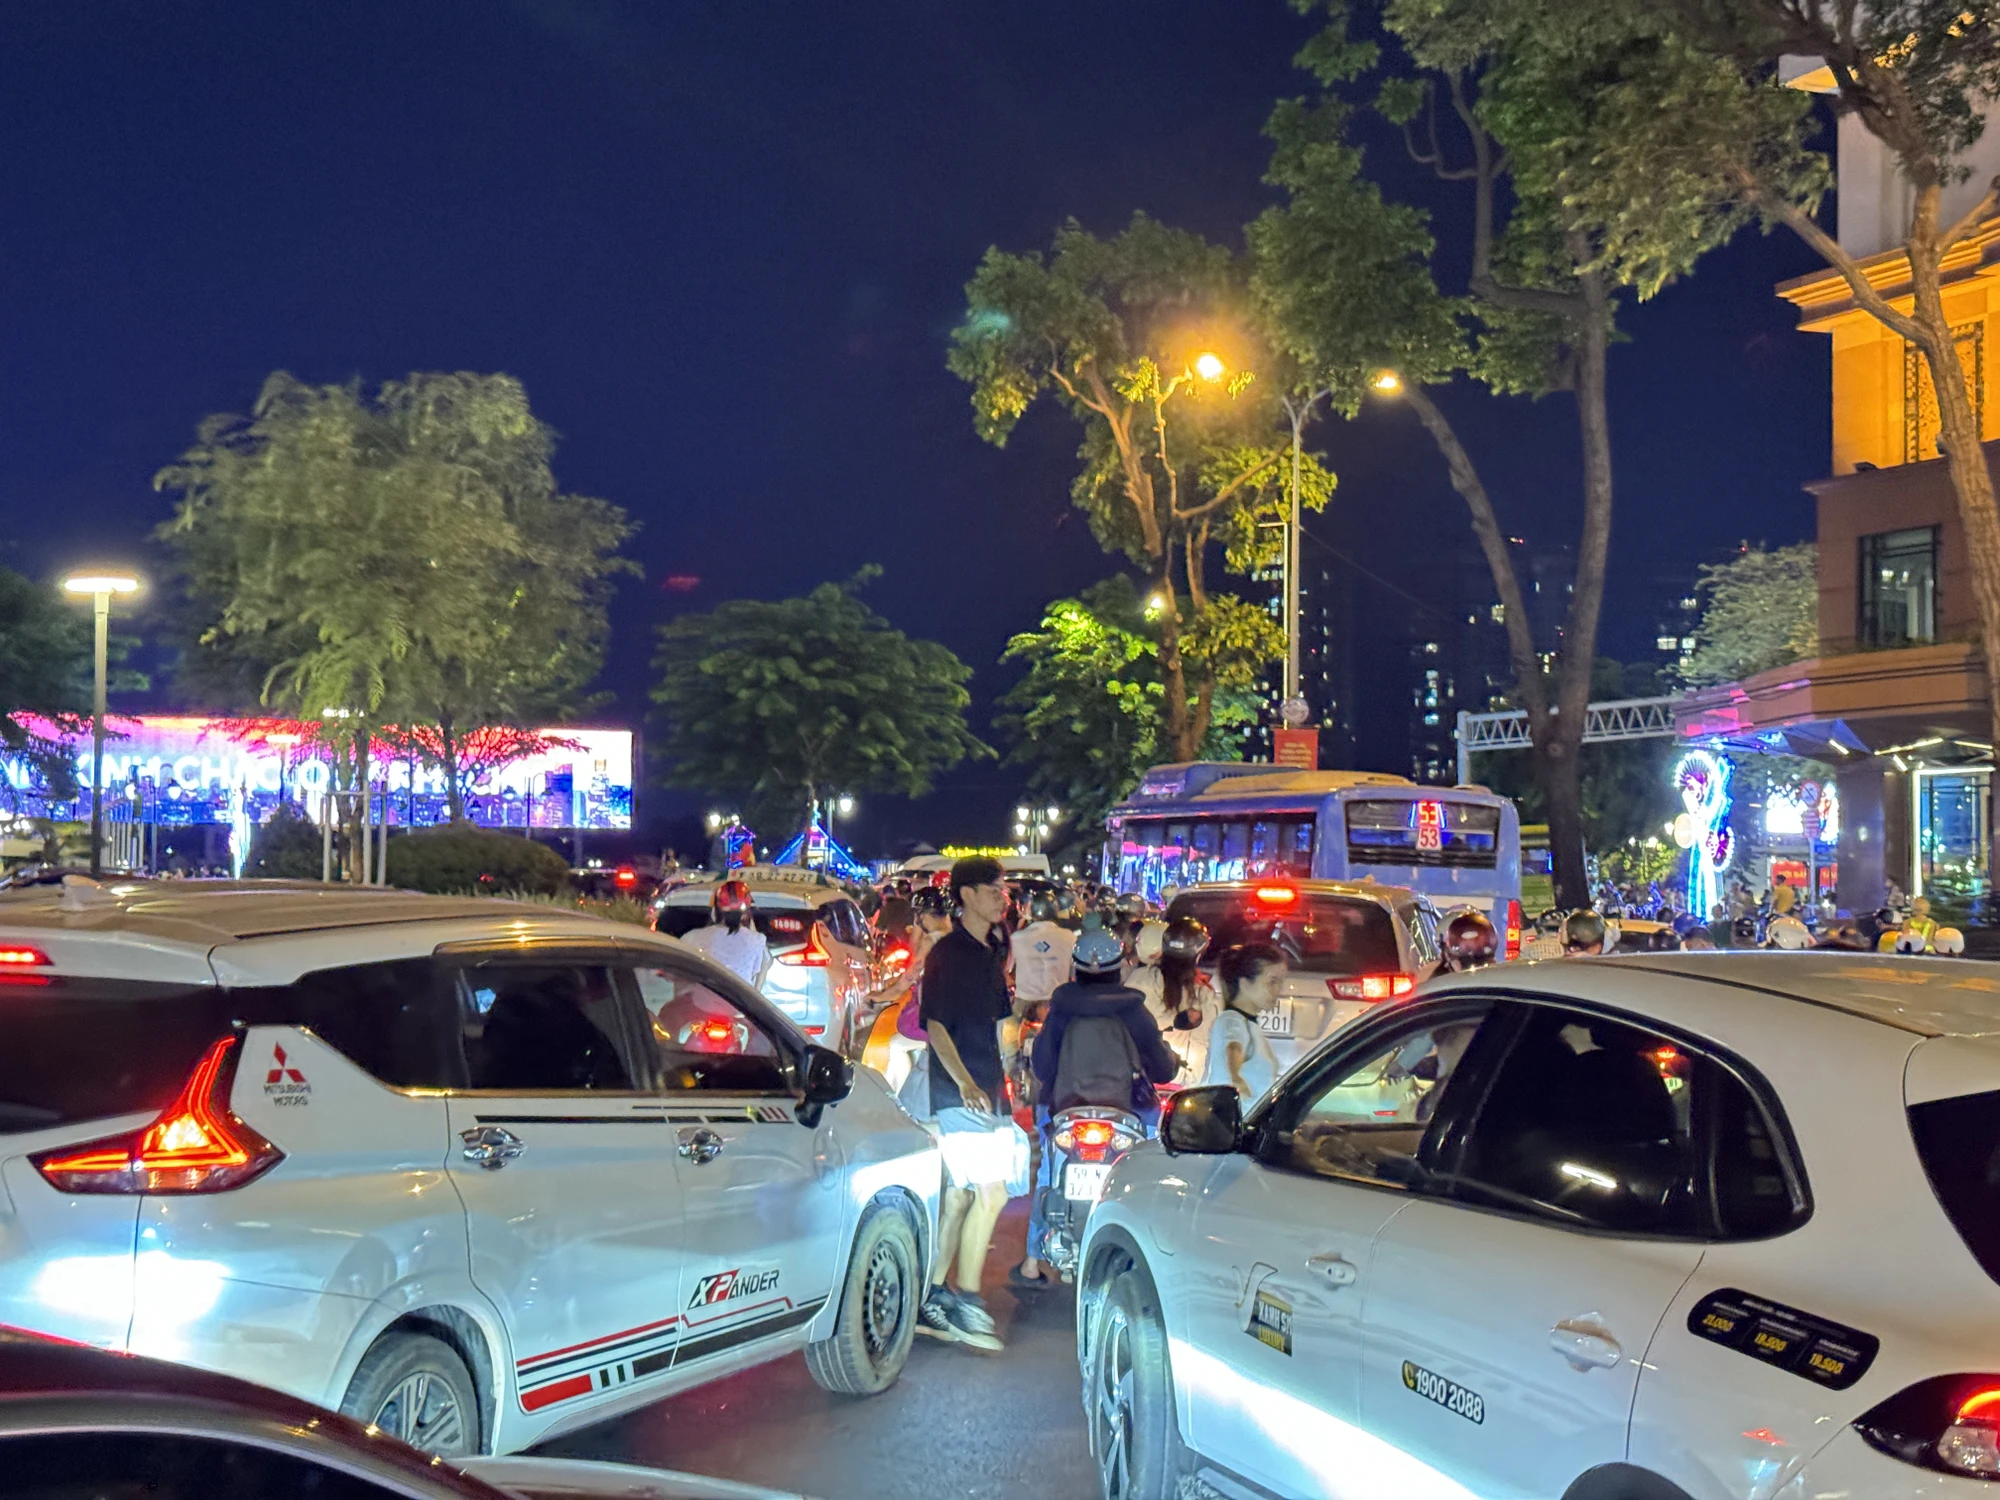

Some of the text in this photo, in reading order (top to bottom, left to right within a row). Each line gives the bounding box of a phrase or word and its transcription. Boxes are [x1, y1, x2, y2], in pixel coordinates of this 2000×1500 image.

[1418, 803, 1439, 825] 53
[1420, 828, 1438, 847] 53
[688, 1268, 780, 1309] XPANDER
[1258, 1300, 1281, 1330] XANH
[1415, 1368, 1483, 1422] 1900 2088
